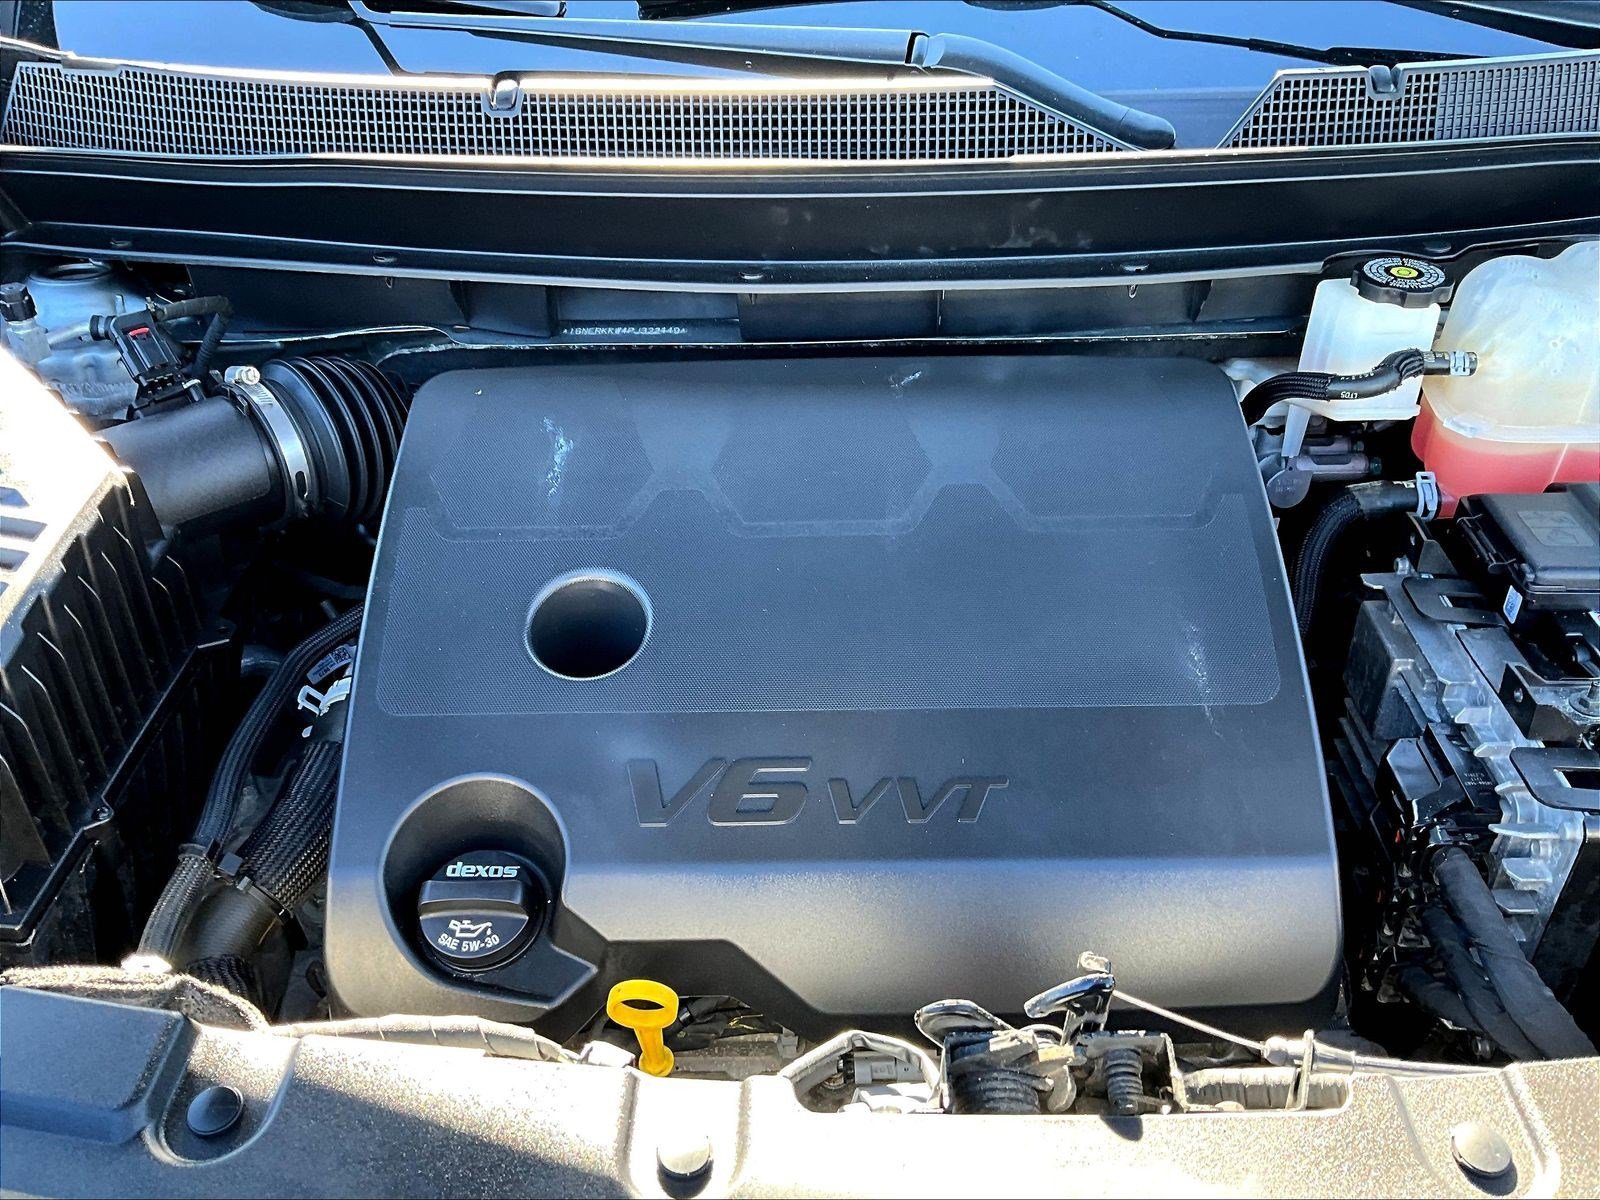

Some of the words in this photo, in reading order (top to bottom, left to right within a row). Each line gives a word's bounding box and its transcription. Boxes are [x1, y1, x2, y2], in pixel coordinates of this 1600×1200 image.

[626, 756, 813, 828] V6
[826, 776, 1010, 825] VVT
[446, 861, 520, 878] dexos
[437, 932, 460, 950] SAE
[461, 934, 500, 952] 5W-30
